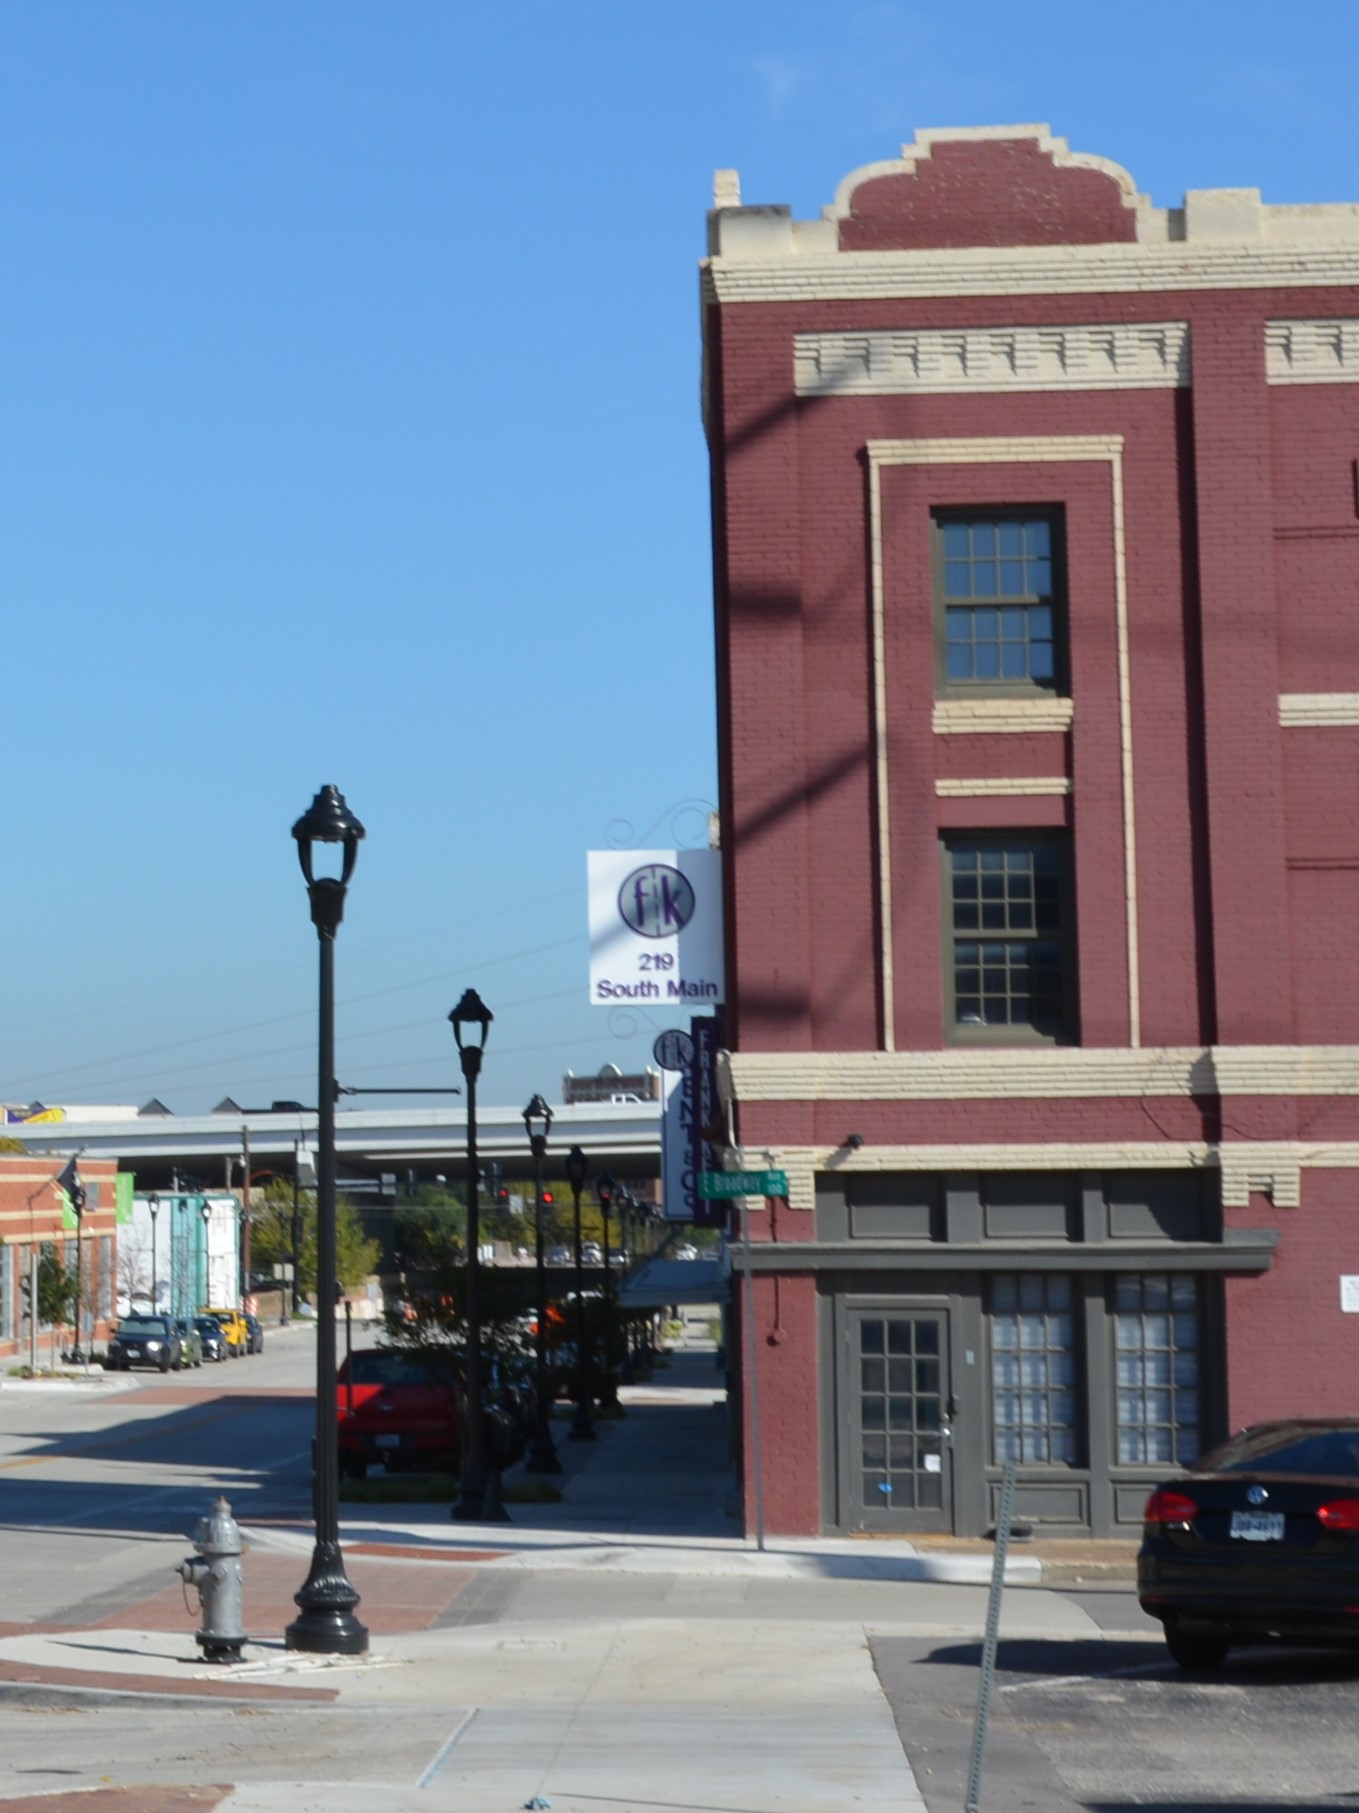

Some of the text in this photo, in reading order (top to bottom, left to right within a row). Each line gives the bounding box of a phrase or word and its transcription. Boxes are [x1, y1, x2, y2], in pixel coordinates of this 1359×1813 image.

[639, 953, 674, 971] 219
[596, 979, 718, 998] South Main
